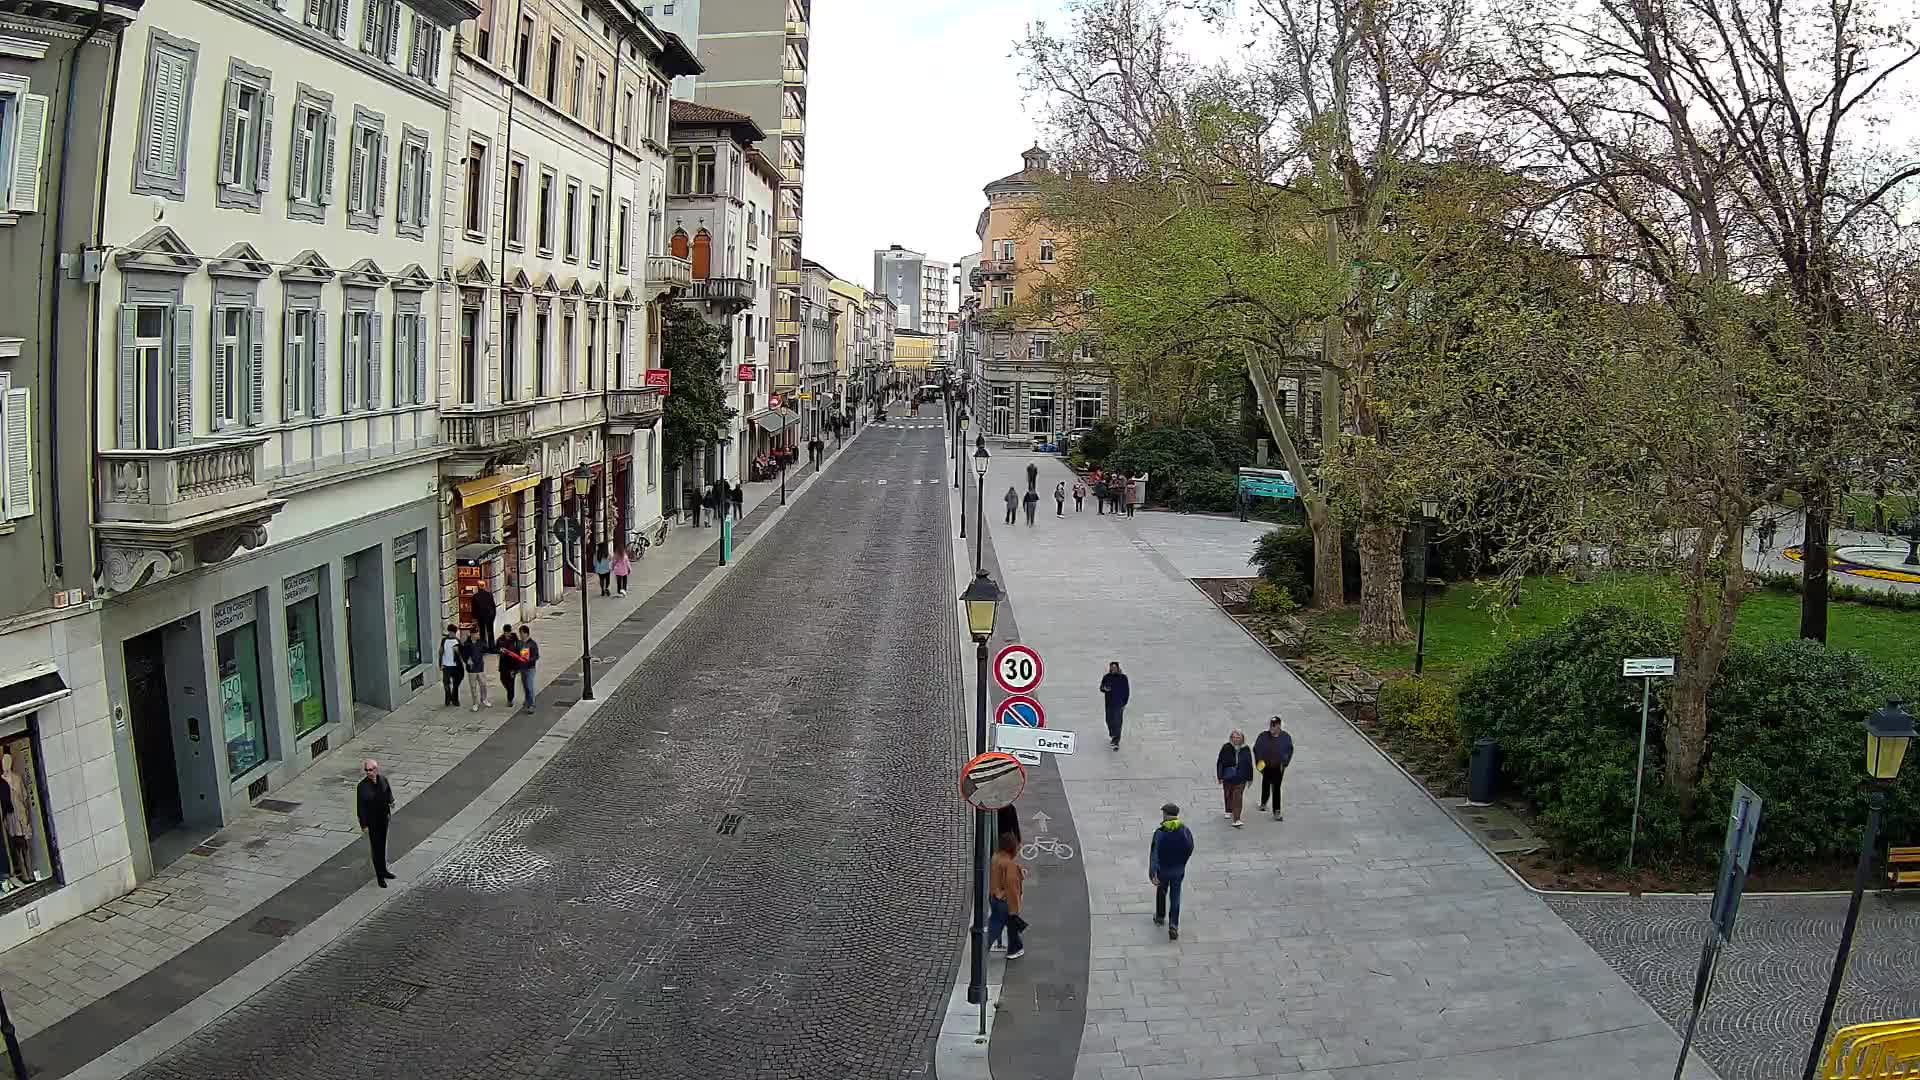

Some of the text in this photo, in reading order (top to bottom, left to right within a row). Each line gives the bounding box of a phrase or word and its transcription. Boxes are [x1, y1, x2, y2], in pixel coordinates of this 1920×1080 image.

[1004, 658, 1033, 681] 30
[221, 677, 240, 700] 130
[1038, 738, 1069, 749] Dante
